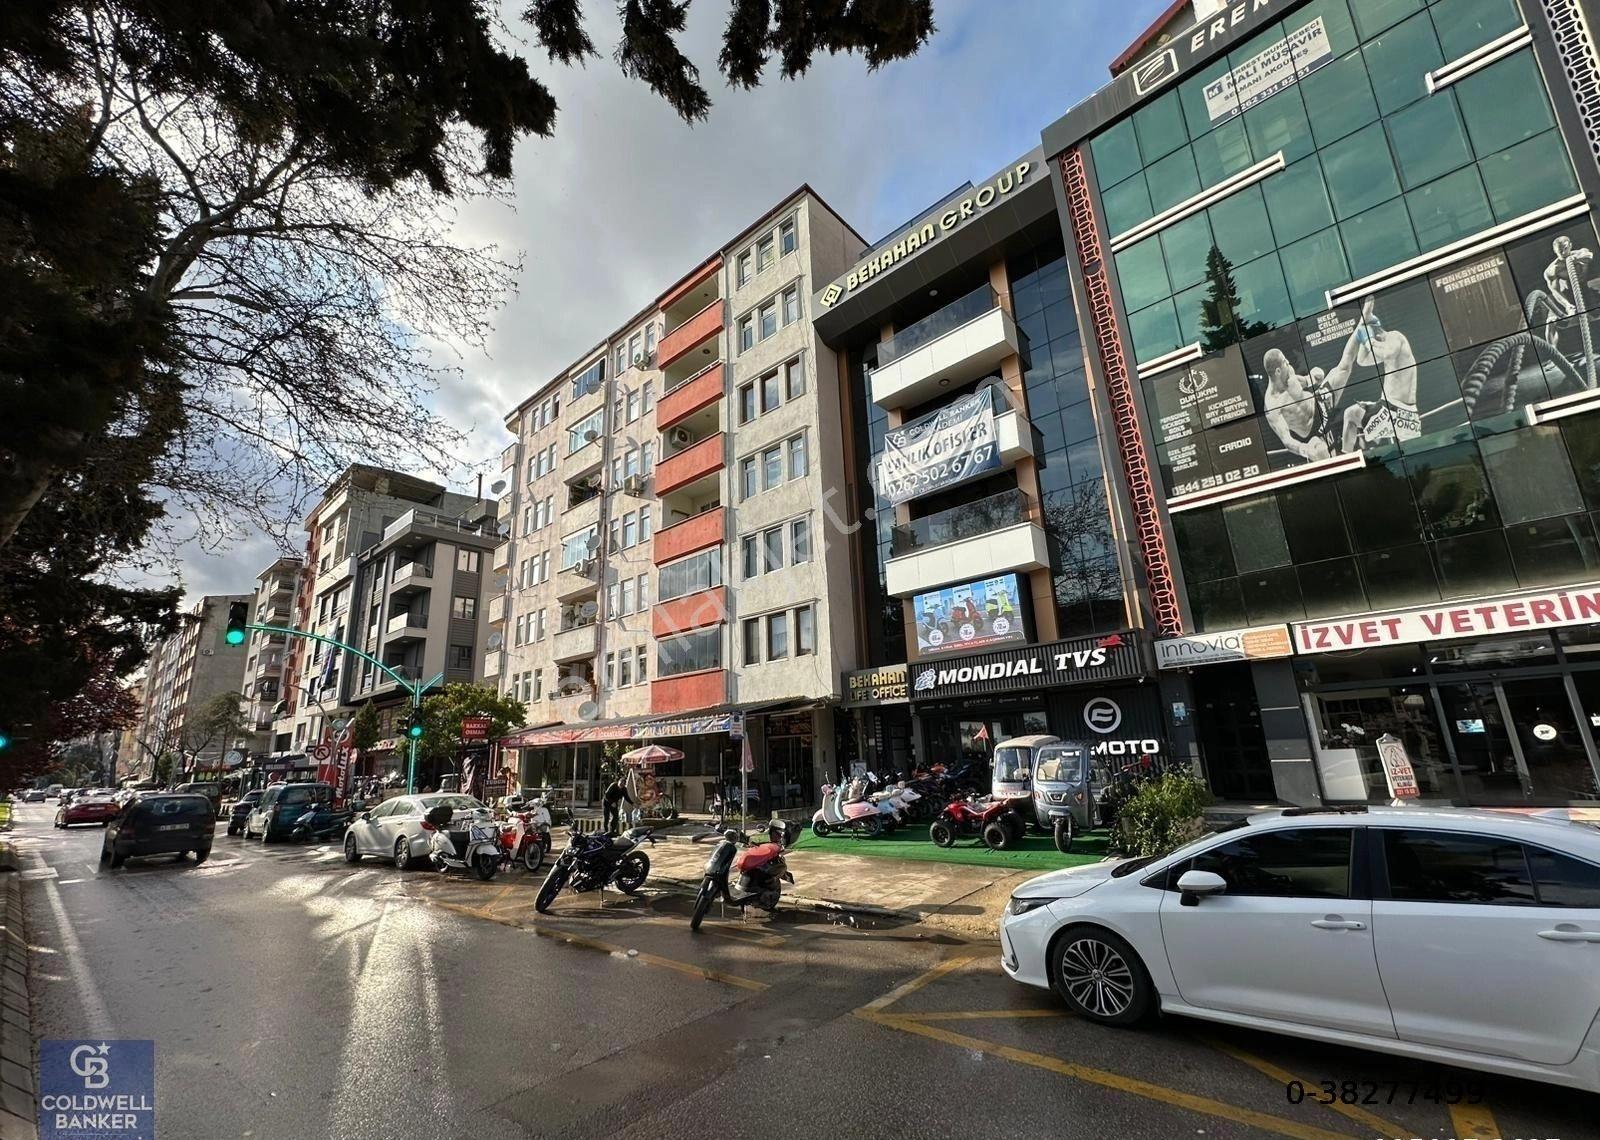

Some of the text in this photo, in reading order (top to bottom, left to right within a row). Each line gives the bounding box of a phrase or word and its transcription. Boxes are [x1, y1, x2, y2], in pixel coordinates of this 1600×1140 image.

[1226, 27, 1322, 90] MALİ MÜŞAVİR
[1231, 107, 1238, 115] 0
[846, 161, 1030, 292] BEKAHAN GROUP
[1444, 267, 1500, 293] ANTREMAN
[1317, 311, 1336, 324] KEEP
[1318, 317, 1339, 330] CALM
[1179, 386, 1218, 405] DURUKAN
[1219, 437, 1252, 454] CARDIO
[922, 464, 948, 484] 502
[952, 454, 971, 473] 67
[974, 444, 993, 464] 67
[1171, 480, 1200, 496] 0544
[1225, 469, 1241, 482] 02
[1243, 464, 1260, 477] 20
[1301, 617, 1402, 650] İZVET
[1160, 636, 1240, 658] innovia
[937, 647, 1106, 686] MONDIAL TVS
[872, 685, 906, 699] OFFICE
